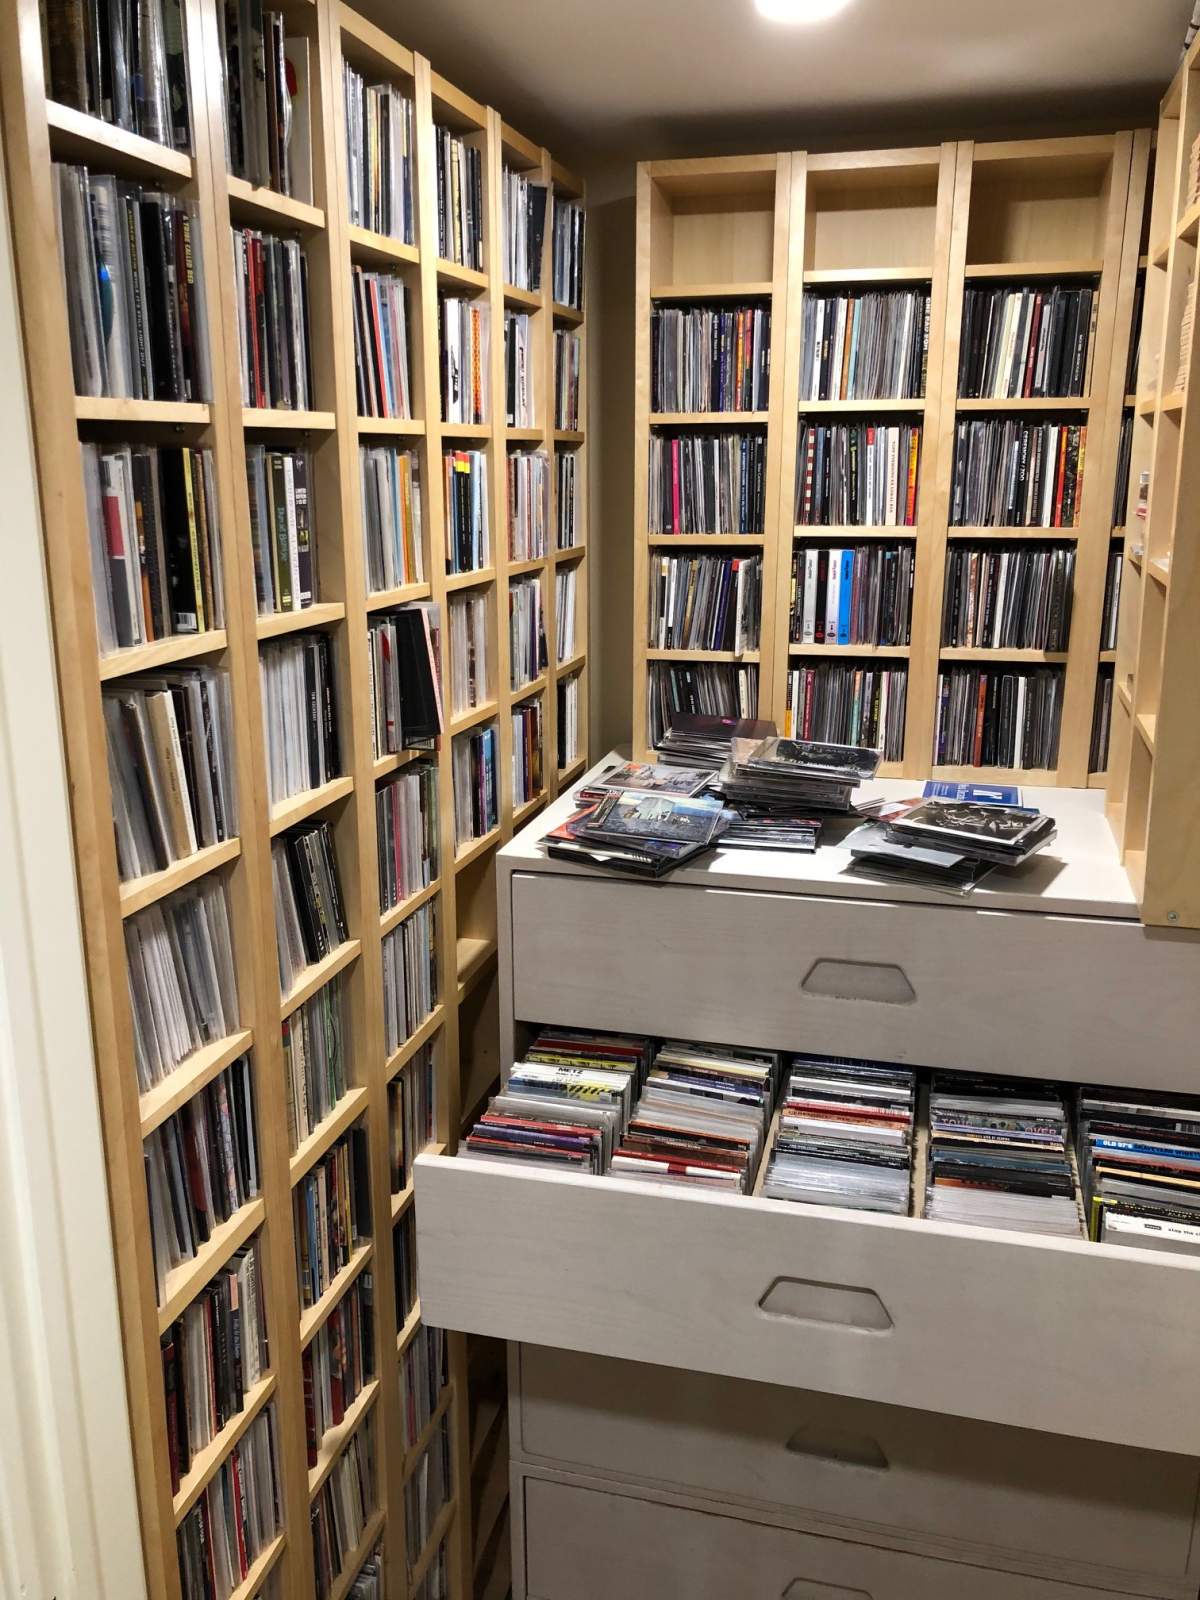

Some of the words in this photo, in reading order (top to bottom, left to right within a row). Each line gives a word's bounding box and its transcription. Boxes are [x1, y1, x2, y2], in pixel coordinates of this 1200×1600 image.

[184, 244, 192, 268] CALLED
[1021, 430, 1029, 464] CEREMONY
[1024, 1127, 1057, 1135] OVER
